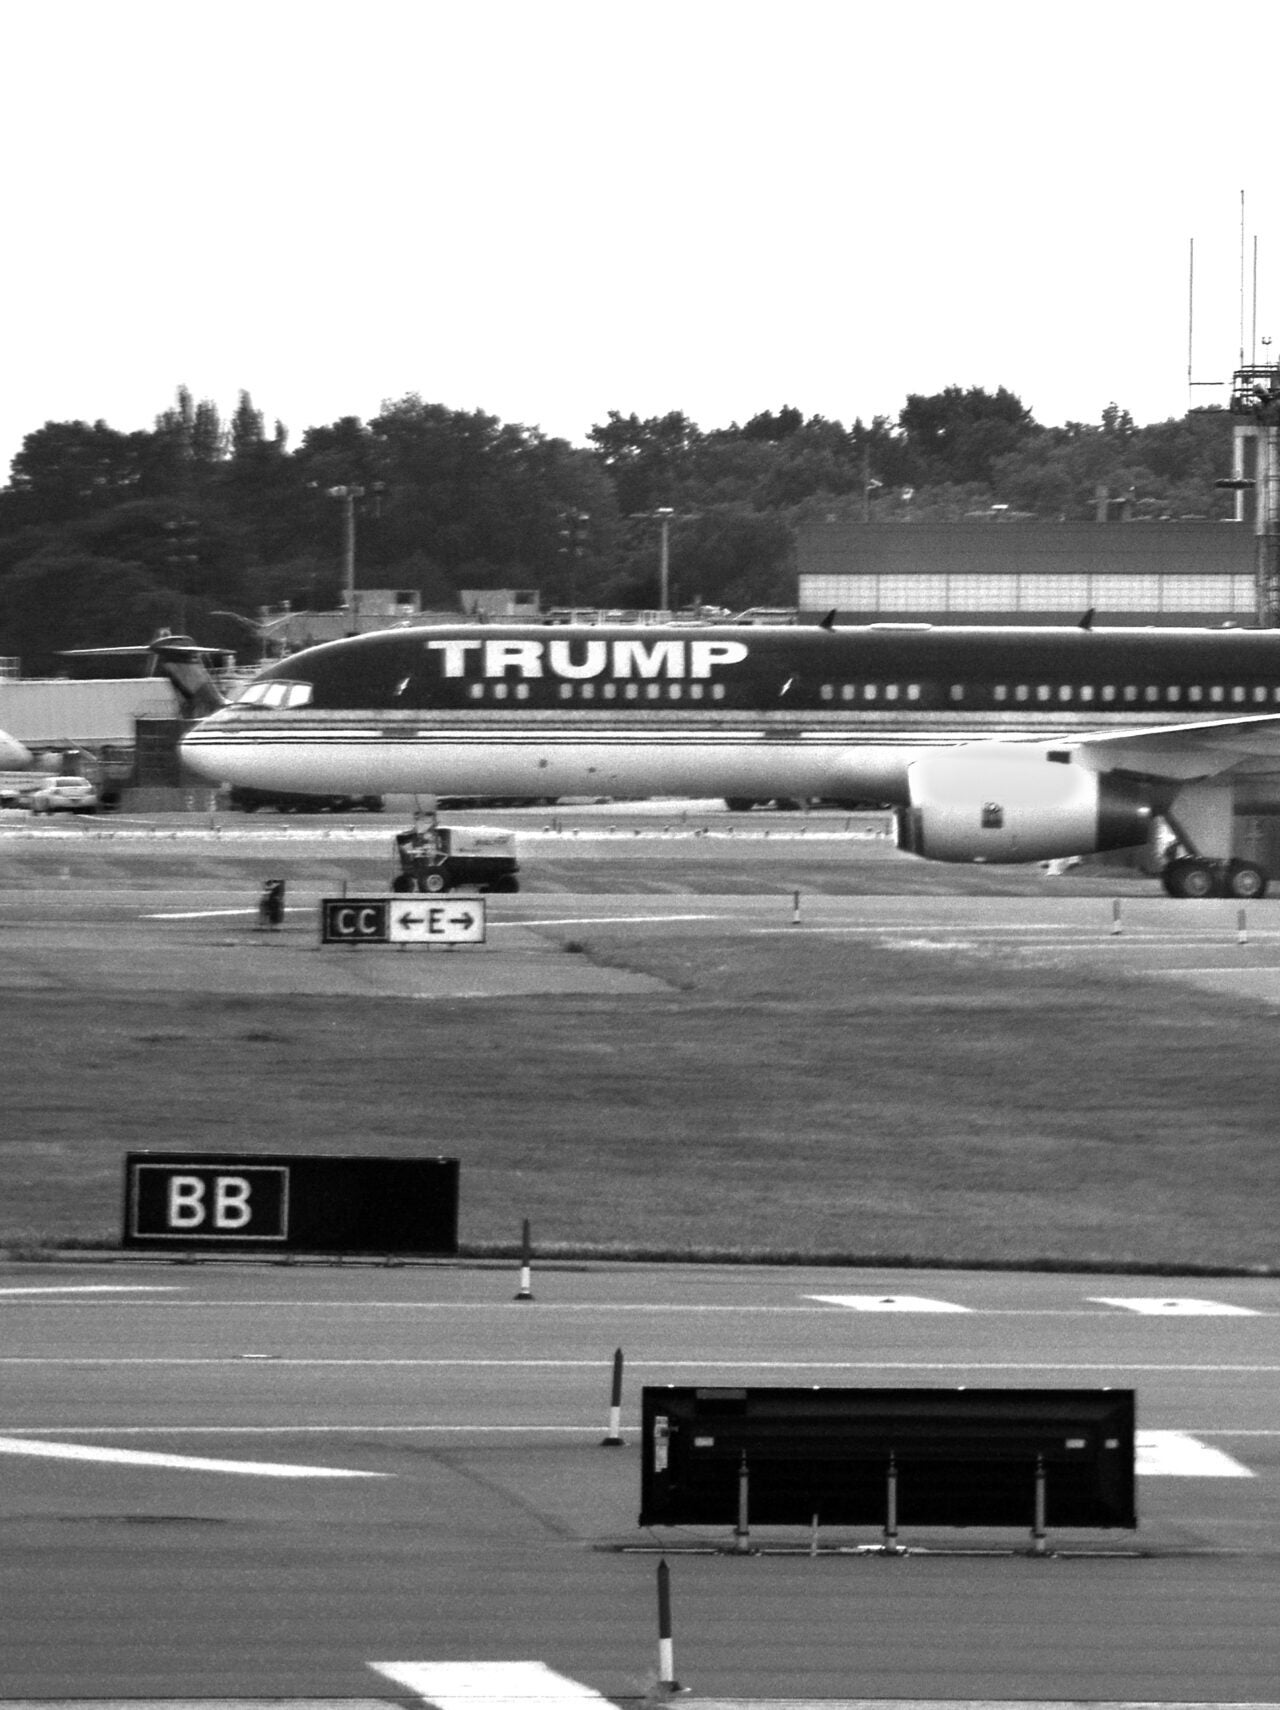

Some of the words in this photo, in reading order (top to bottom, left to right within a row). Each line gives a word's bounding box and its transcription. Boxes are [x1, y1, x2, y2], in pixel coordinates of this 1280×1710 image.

[427, 639, 749, 679] TRUMP
[336, 908, 377, 934] CC
[428, 908, 445, 934] E
[168, 1175, 253, 1229] BB
